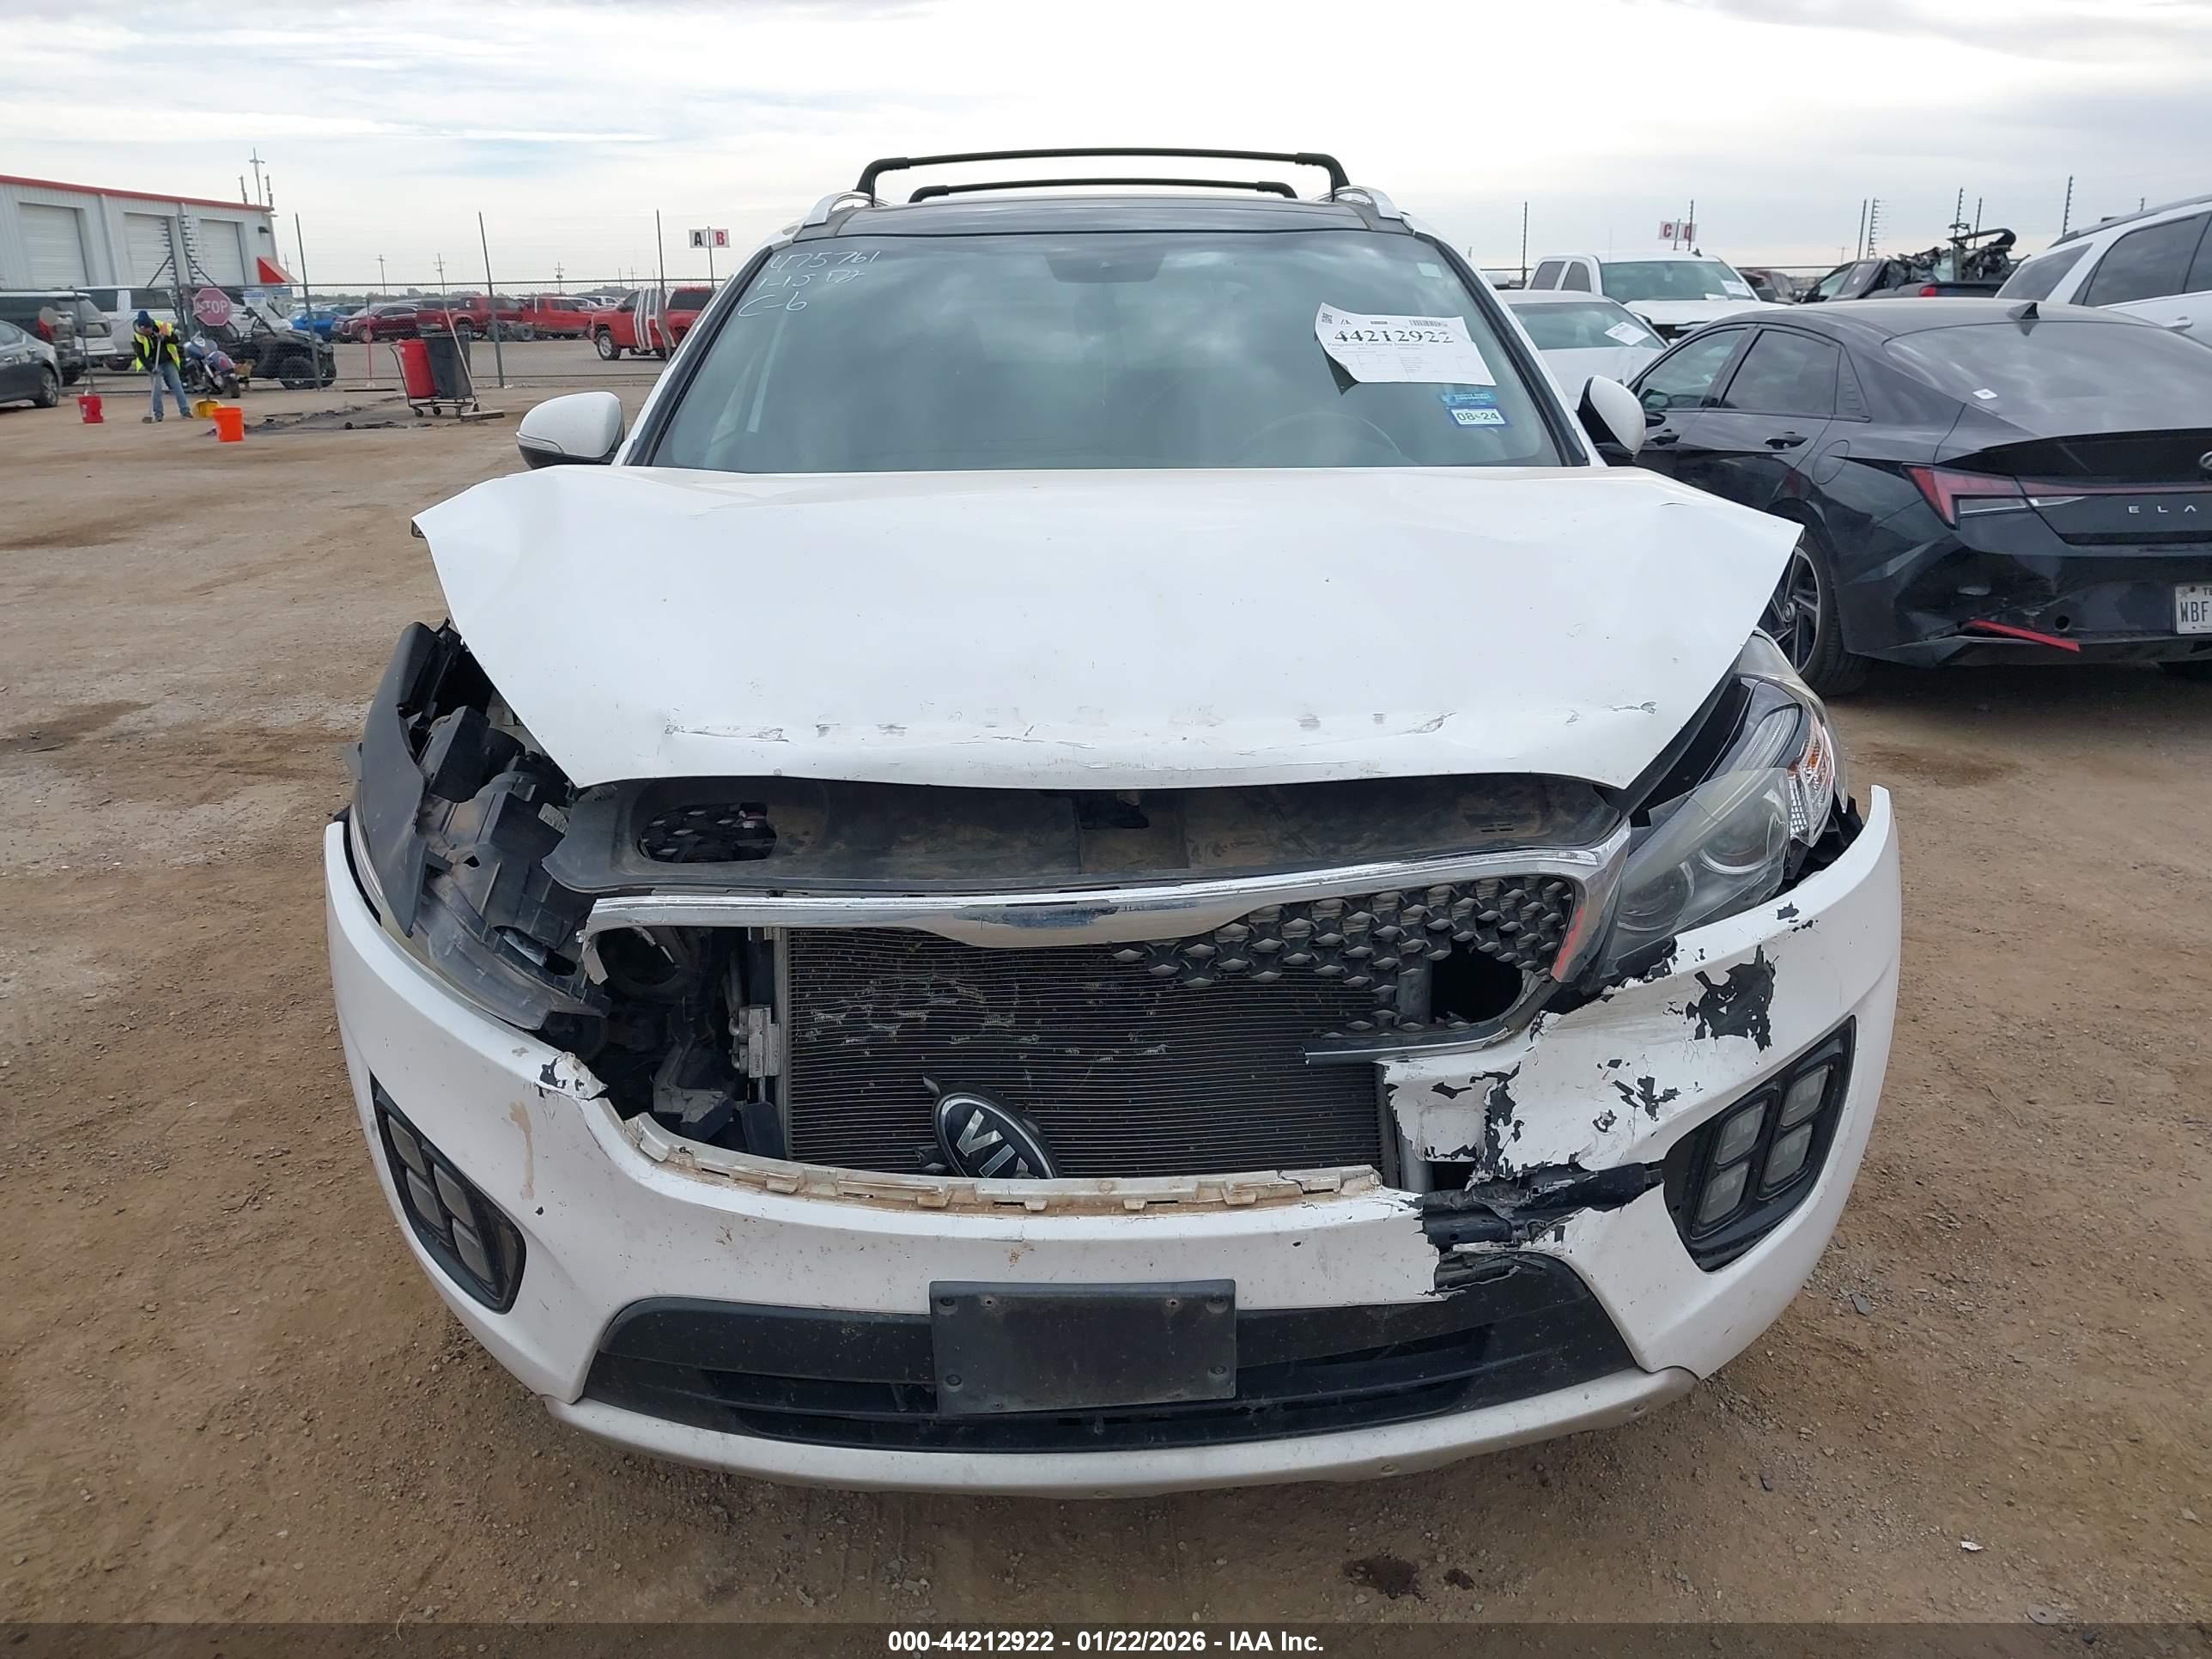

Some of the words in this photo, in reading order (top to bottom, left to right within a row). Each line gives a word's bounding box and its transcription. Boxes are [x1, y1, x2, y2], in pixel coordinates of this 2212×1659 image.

[1663, 223, 1672, 238] C
[694, 231, 703, 246] A
[715, 231, 725, 246] B
[197, 301, 228, 313] STOP
[1334, 330, 1455, 344] 44212922
[2128, 504, 2197, 514] ELA
[2180, 600, 2209, 623] WBF
